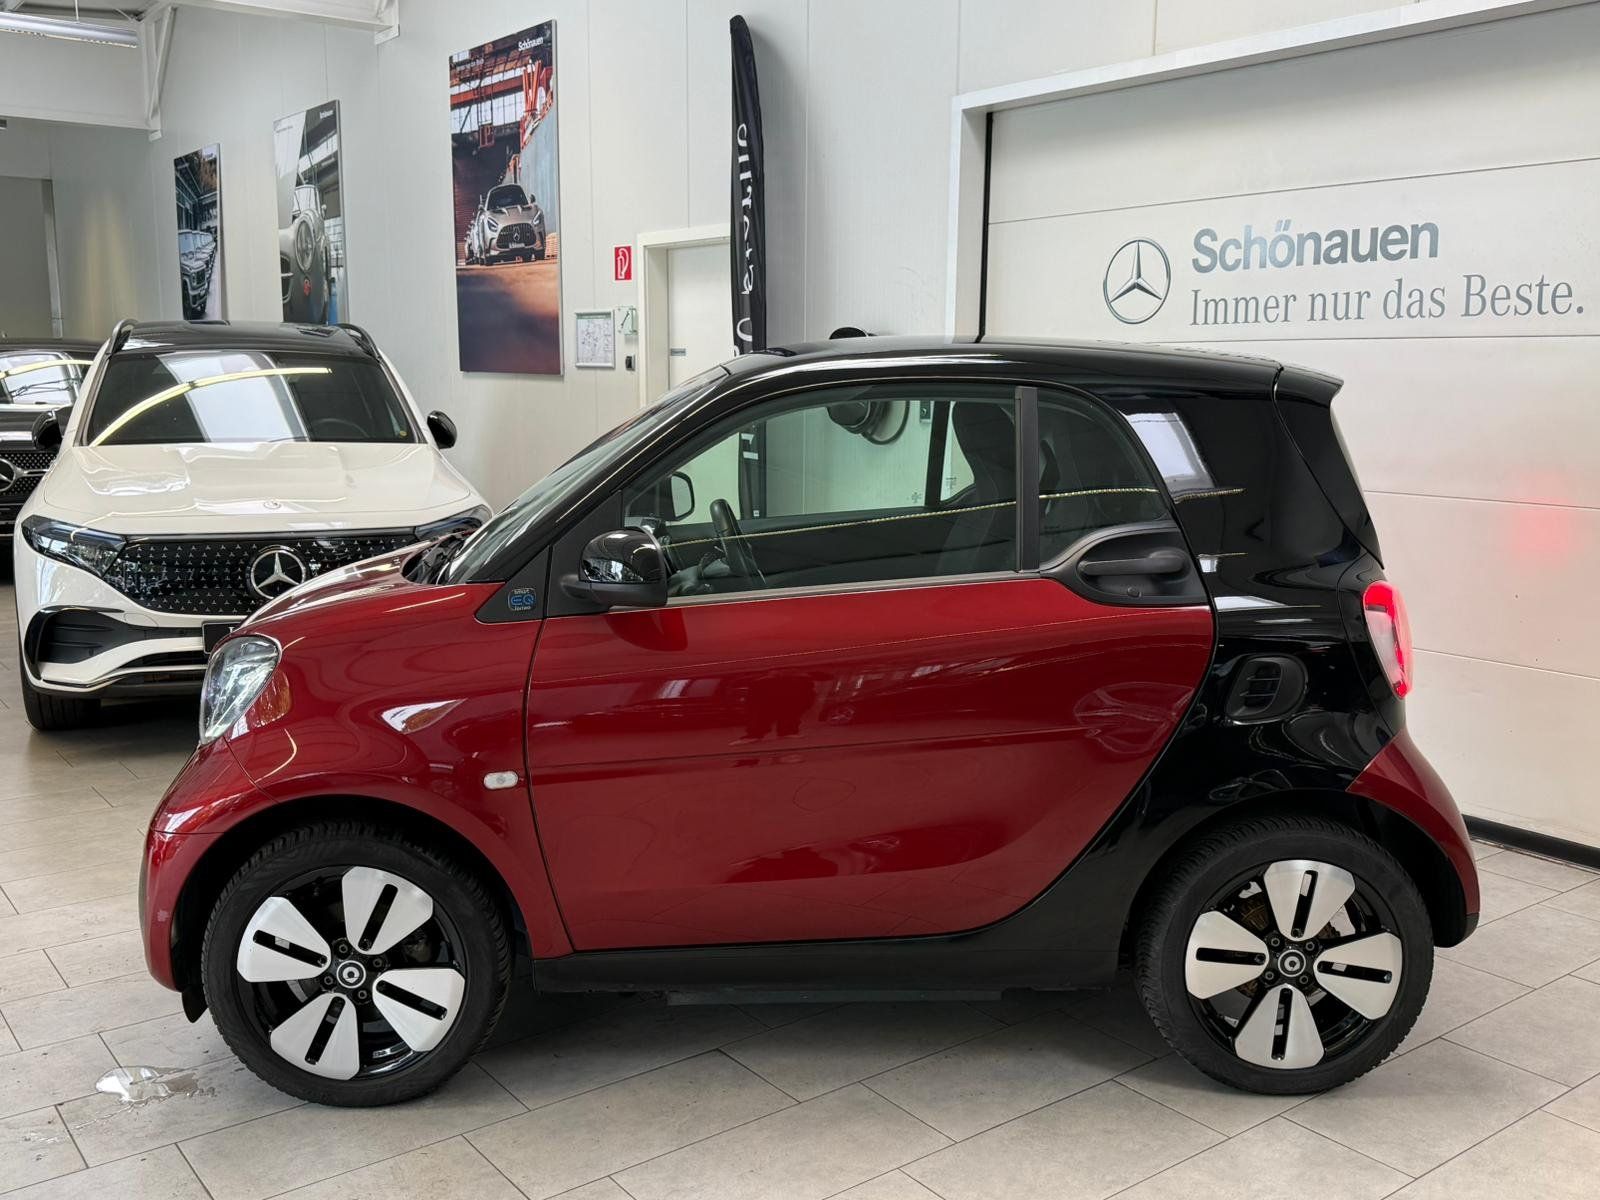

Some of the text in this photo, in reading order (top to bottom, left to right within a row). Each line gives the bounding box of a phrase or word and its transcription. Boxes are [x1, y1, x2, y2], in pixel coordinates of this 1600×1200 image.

[1191, 218, 1440, 274] Schönauen
[1189, 273, 1585, 326] Immer nur das Beste.
